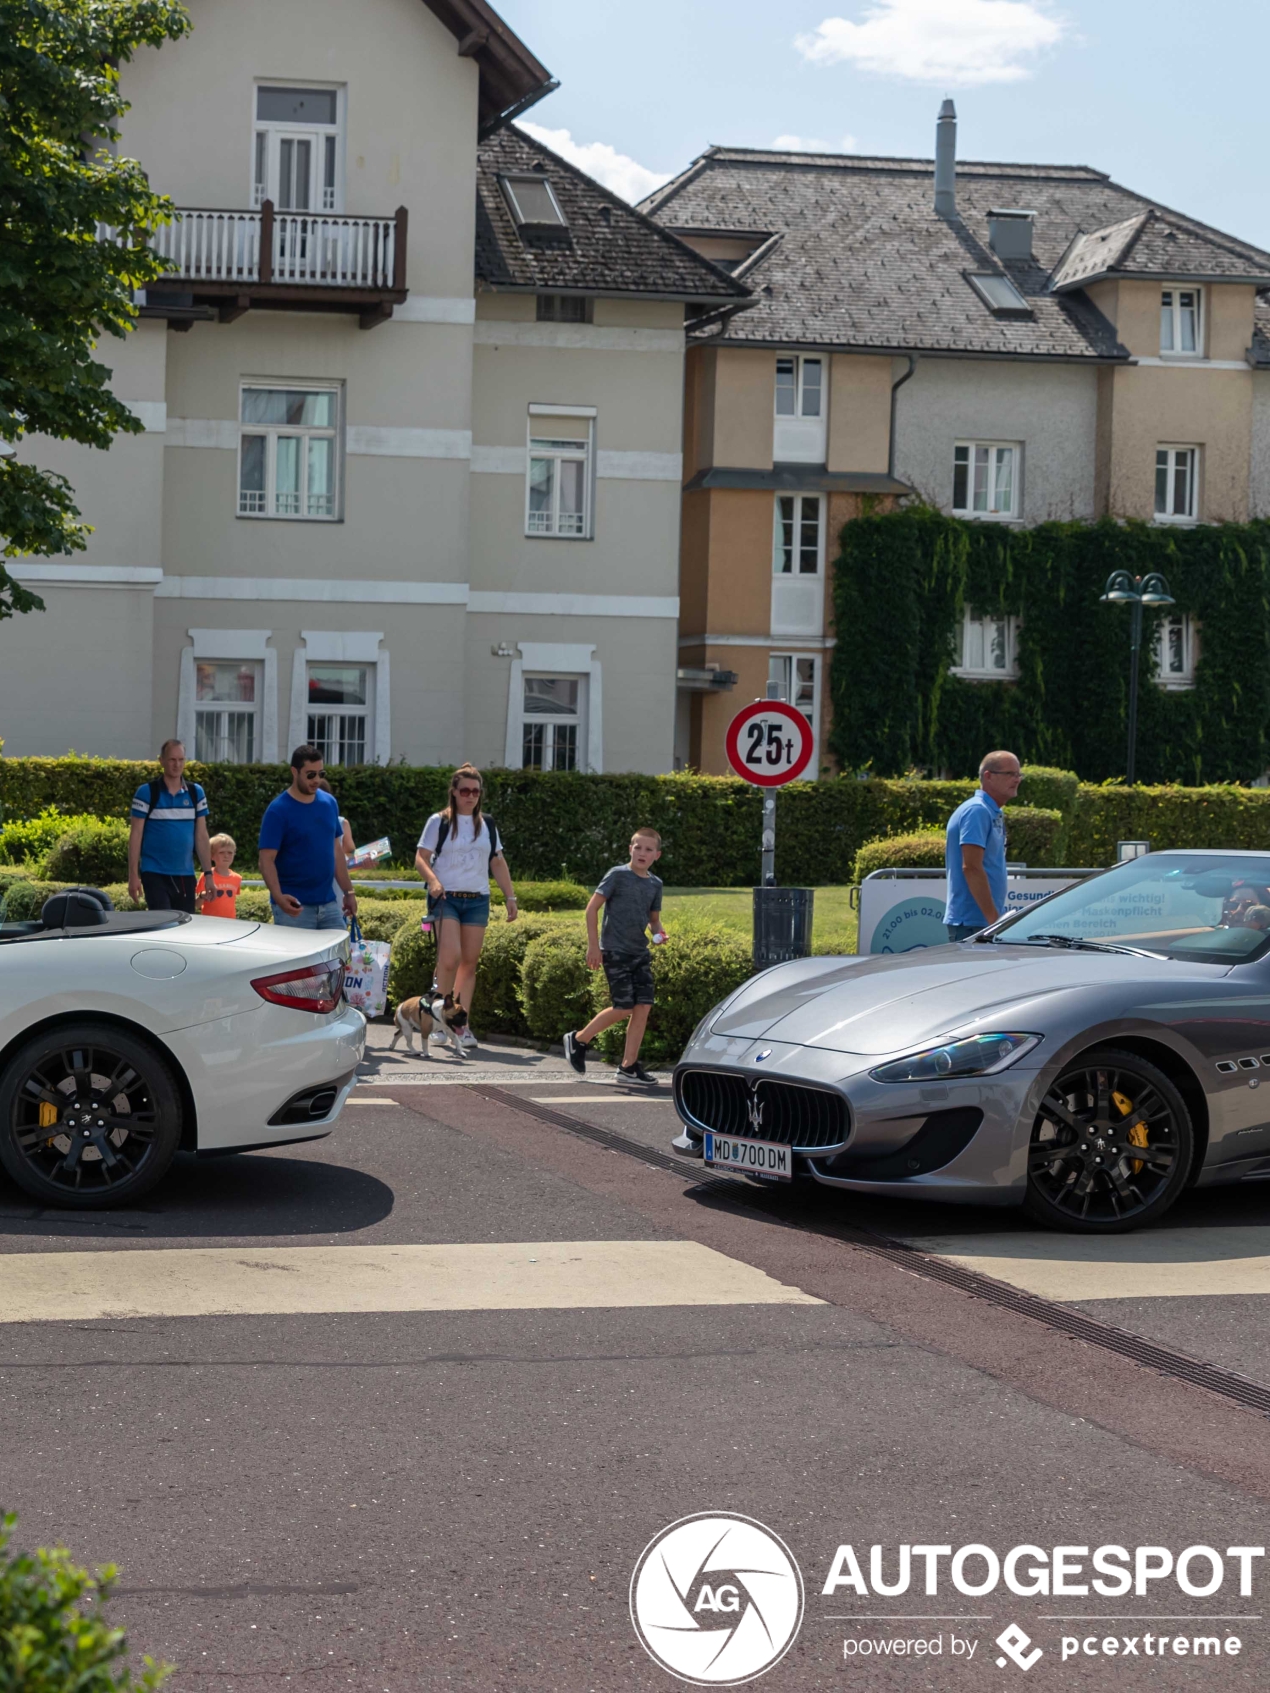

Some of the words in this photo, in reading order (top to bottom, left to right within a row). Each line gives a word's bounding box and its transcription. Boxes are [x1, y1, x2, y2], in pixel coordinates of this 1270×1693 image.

[882, 916, 903, 940] 21.00
[904, 909, 918, 920] bis
[1073, 918, 1117, 928] Bereich
[714, 1138, 730, 1160] MD
[740, 1143, 766, 1167] 700
[768, 1148, 786, 1171] DM
